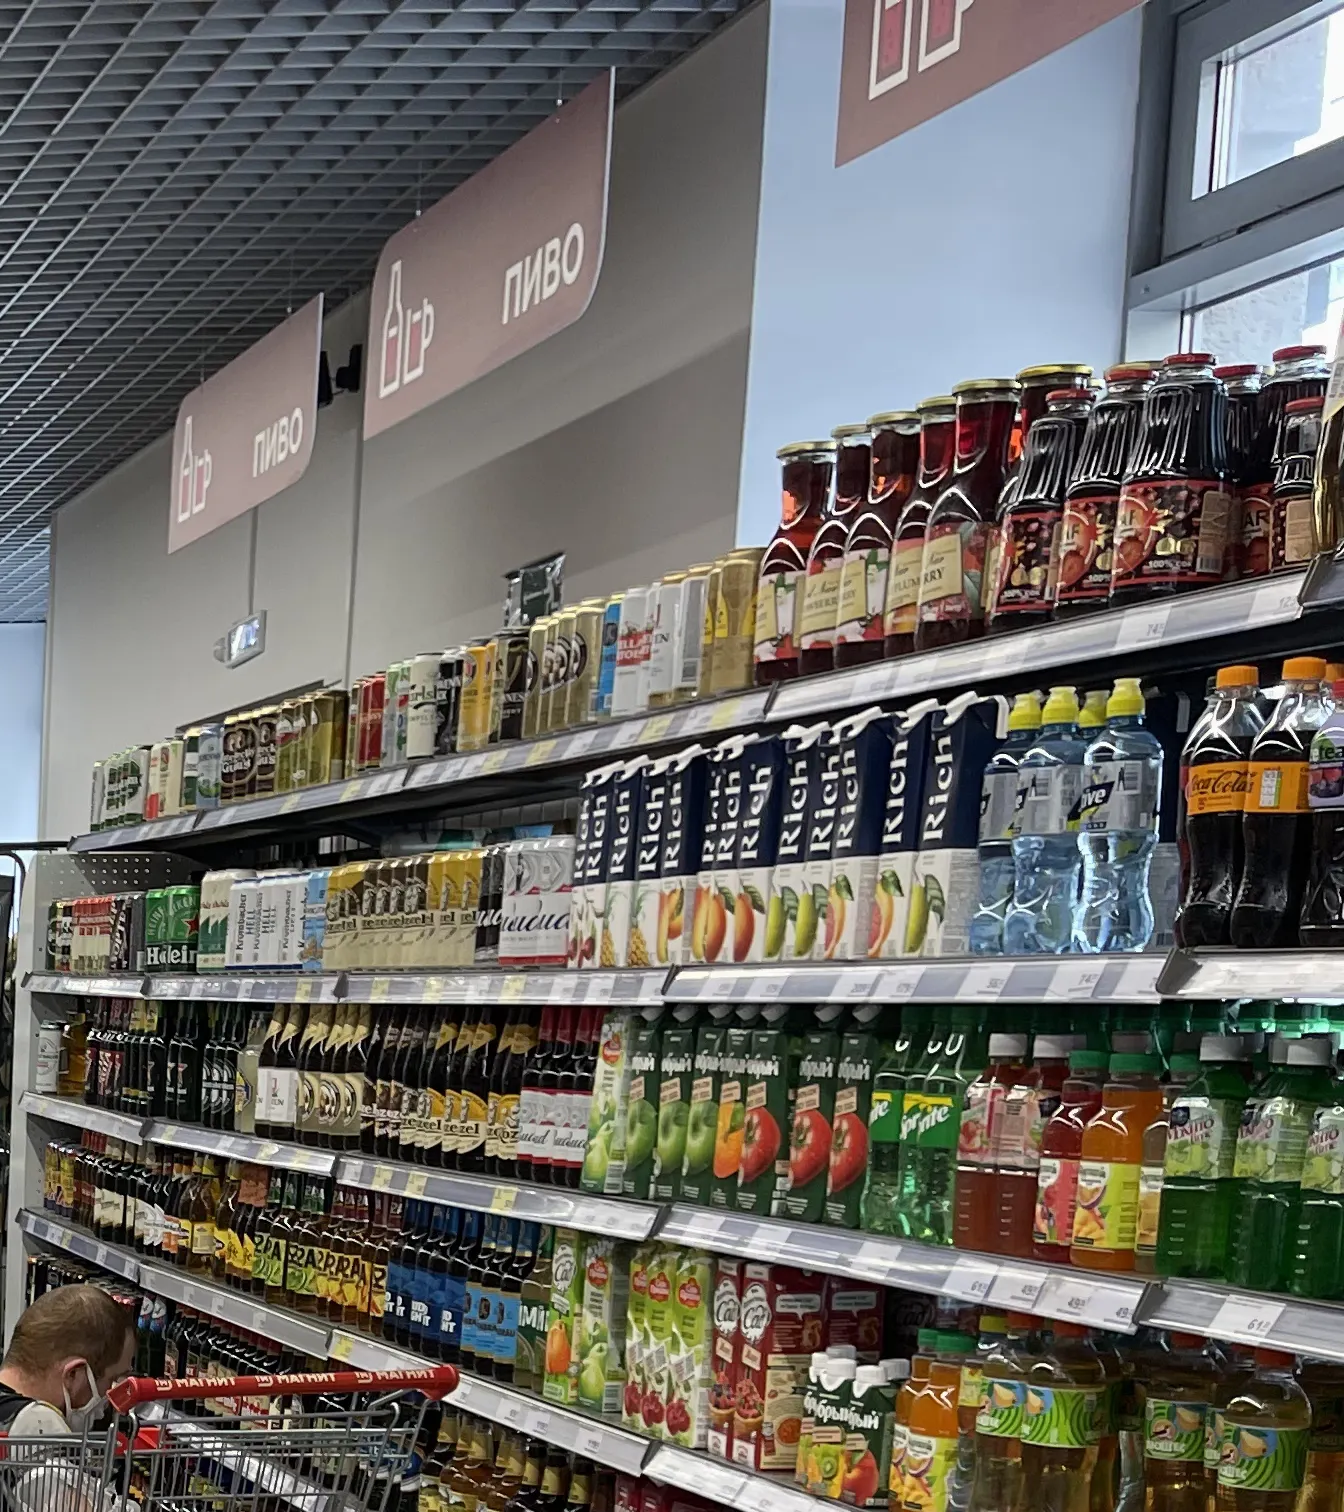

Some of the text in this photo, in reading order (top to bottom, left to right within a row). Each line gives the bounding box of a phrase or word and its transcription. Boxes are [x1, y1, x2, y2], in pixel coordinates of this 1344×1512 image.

[502, 222, 584, 325] ПИВО
[252, 407, 304, 478] ПИВО
[638, 786, 665, 872] Rich
[717, 771, 741, 861] Rich
[740, 766, 771, 860] Rich
[778, 759, 808, 856] Rich
[810, 754, 841, 852] Rich
[835, 749, 859, 849] Rich
[882, 739, 909, 844] Rich
[922, 735, 953, 841] Rich
[176, 1376, 236, 1388] МАГНИТ
[277, 1371, 336, 1383] МАГНИТ
[376, 1369, 436, 1381] МАГНИТ
